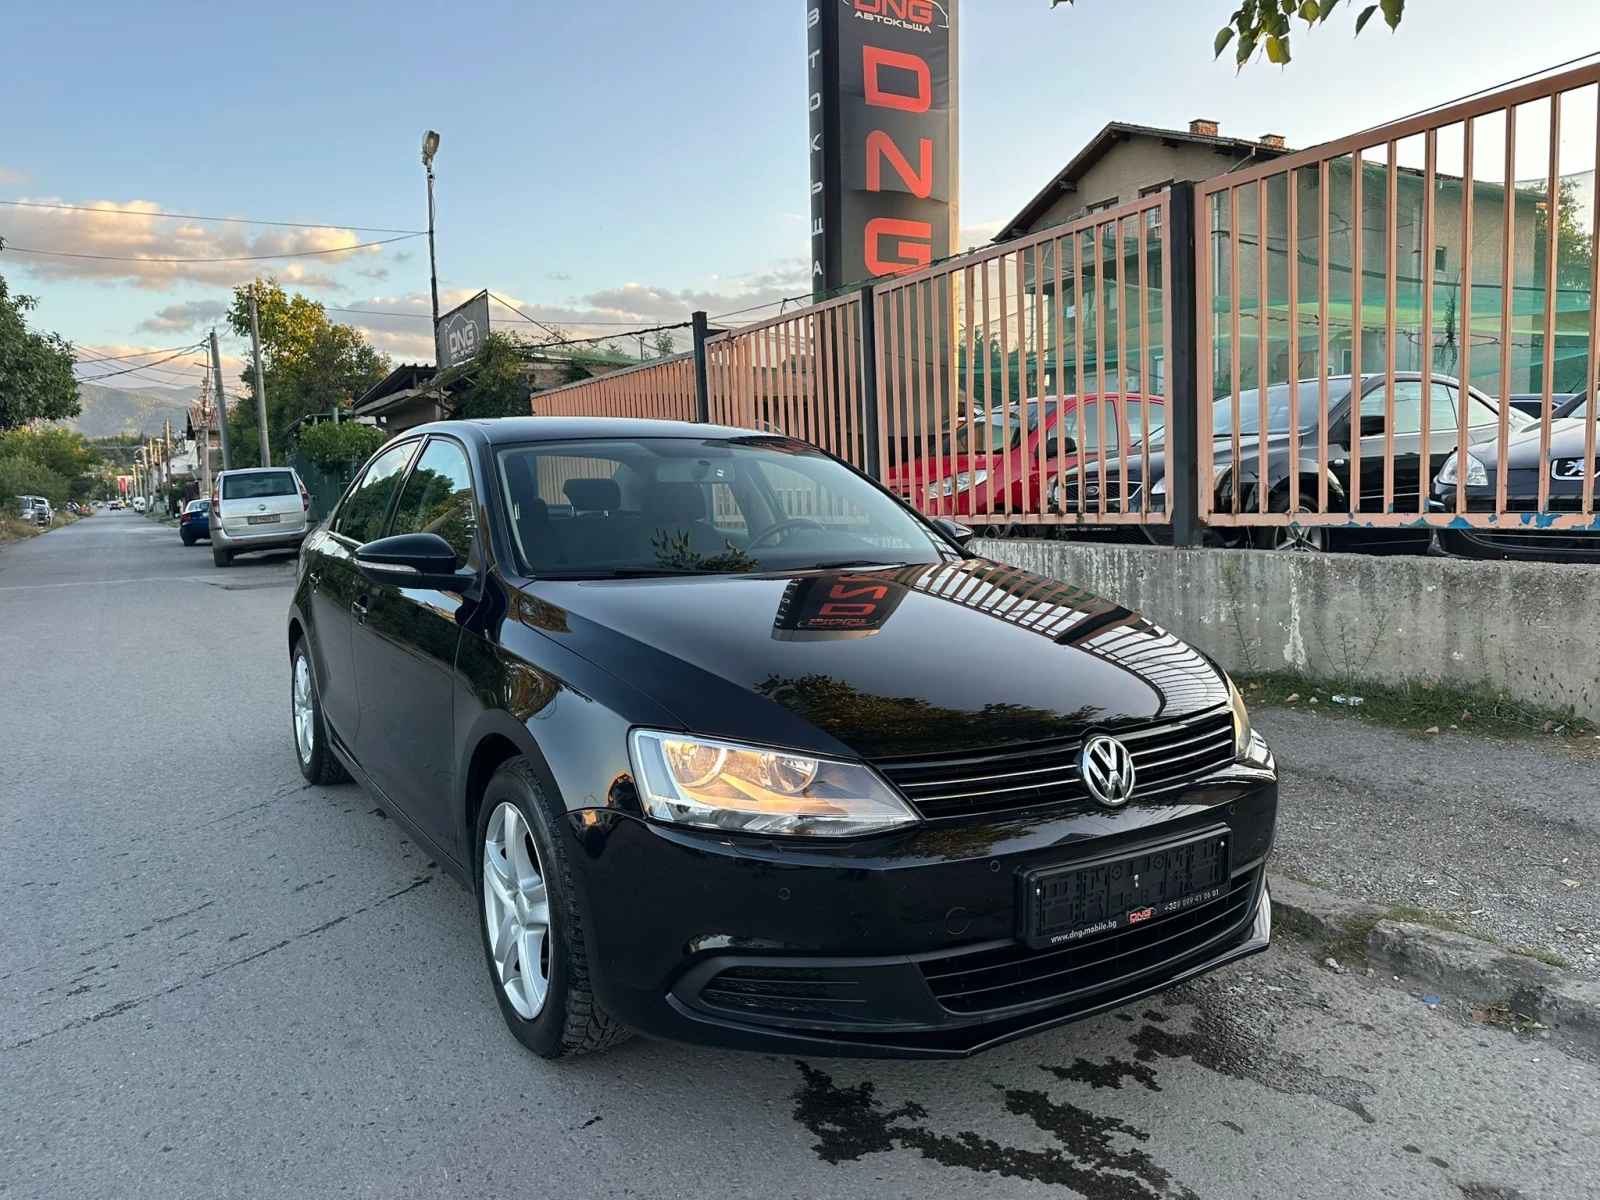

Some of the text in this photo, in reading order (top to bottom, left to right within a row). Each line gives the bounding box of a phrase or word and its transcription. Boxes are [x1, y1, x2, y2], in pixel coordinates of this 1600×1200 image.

[854, 10, 932, 34] АВТОКЪЩА
[863, 45, 932, 276] DNG
[449, 323, 474, 354] DNG
[1051, 920, 1117, 944] www.dng.mobile.bg
